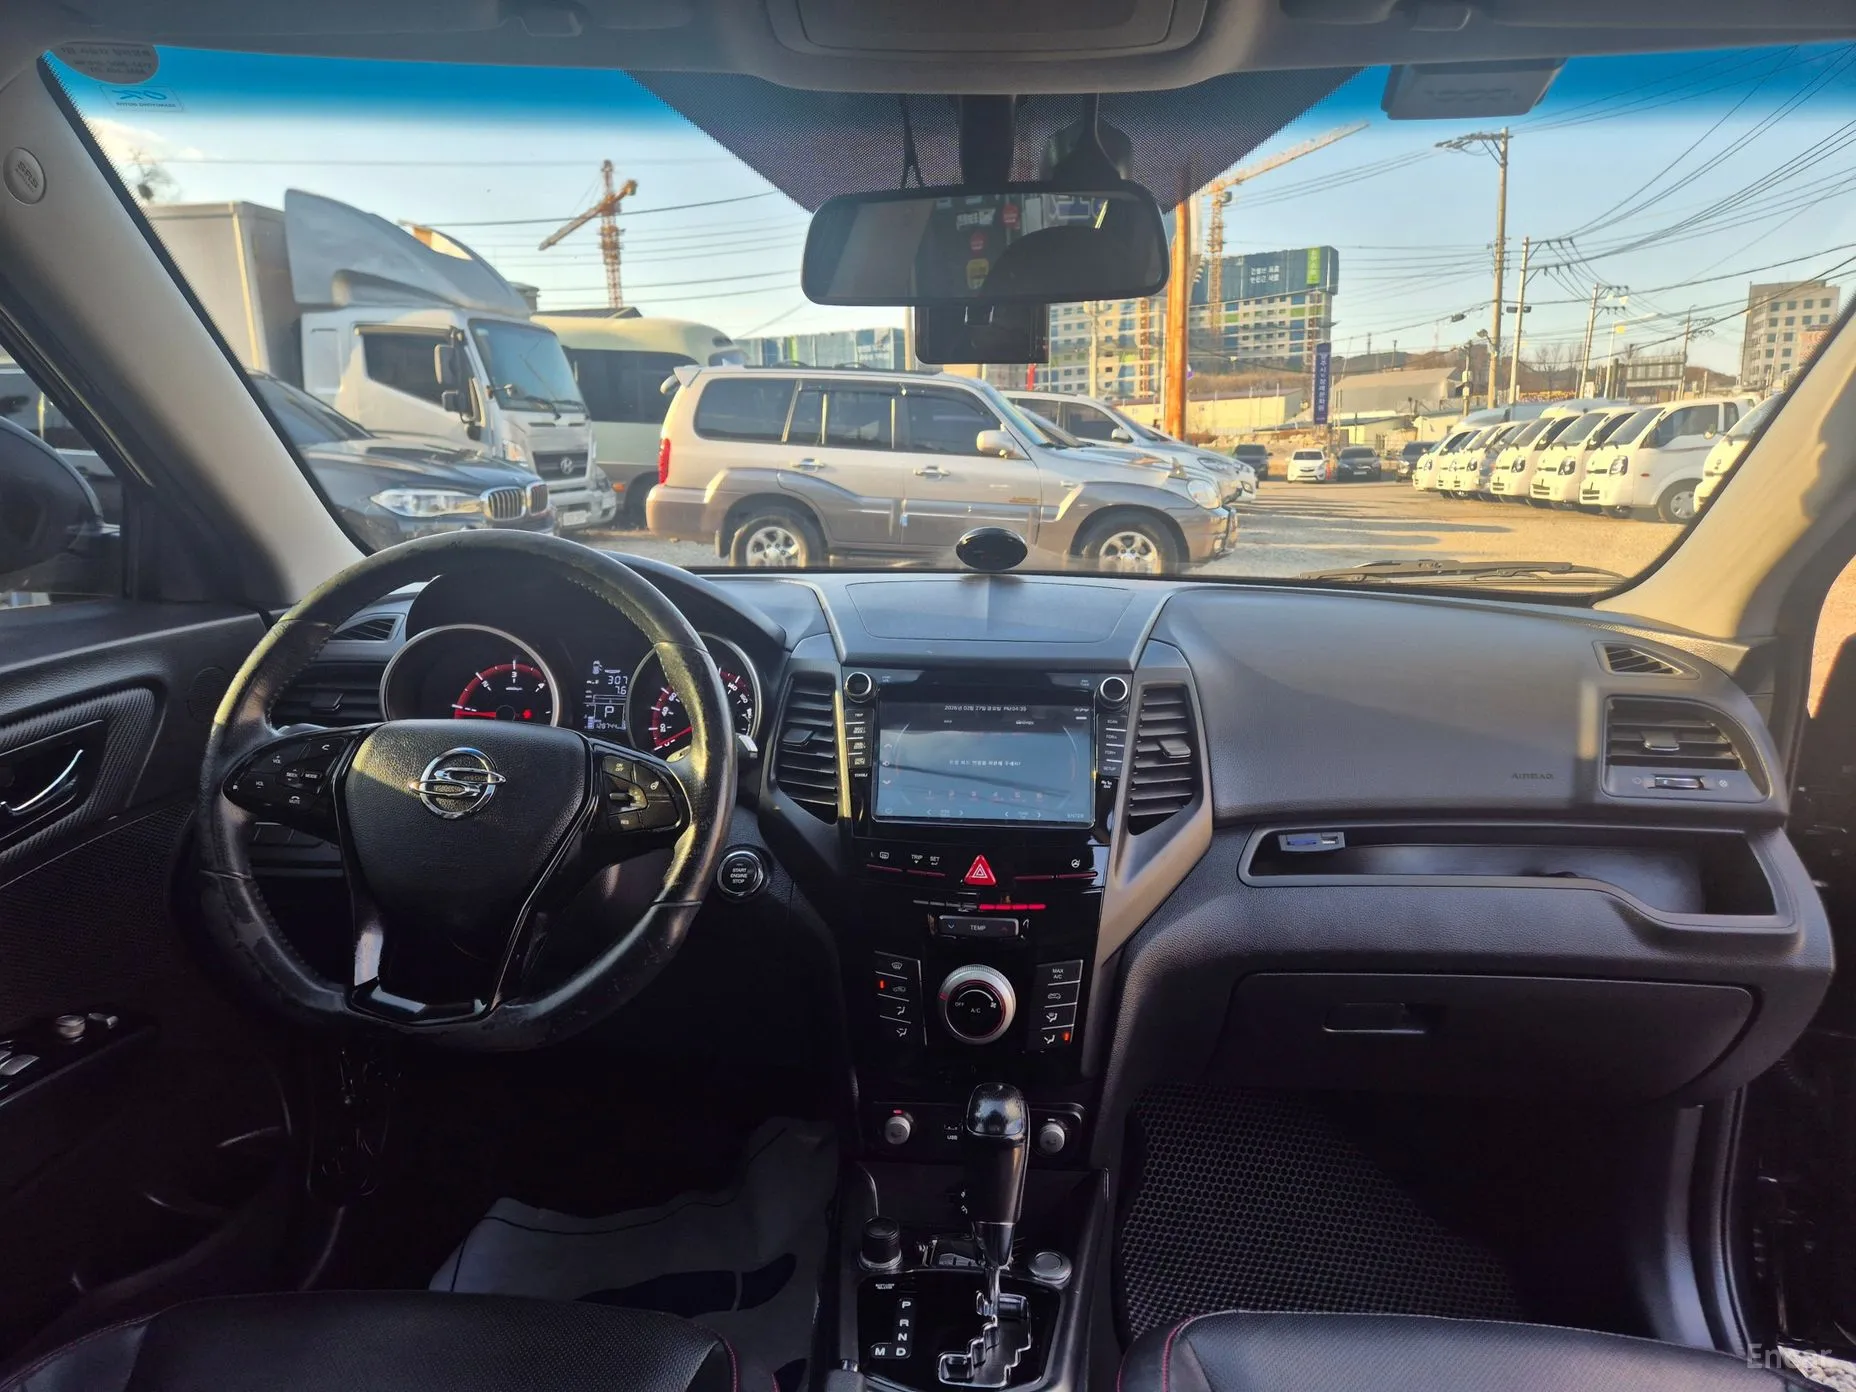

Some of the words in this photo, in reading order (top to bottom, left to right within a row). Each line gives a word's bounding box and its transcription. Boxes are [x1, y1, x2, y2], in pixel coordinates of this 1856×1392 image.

[607, 675, 628, 684] 307
[604, 705, 614, 718] P
[901, 1301, 911, 1309] P
[899, 1319, 909, 1327] R
[897, 1333, 907, 1341] N
[874, 1347, 886, 1356] M
[896, 1347, 906, 1356] D
